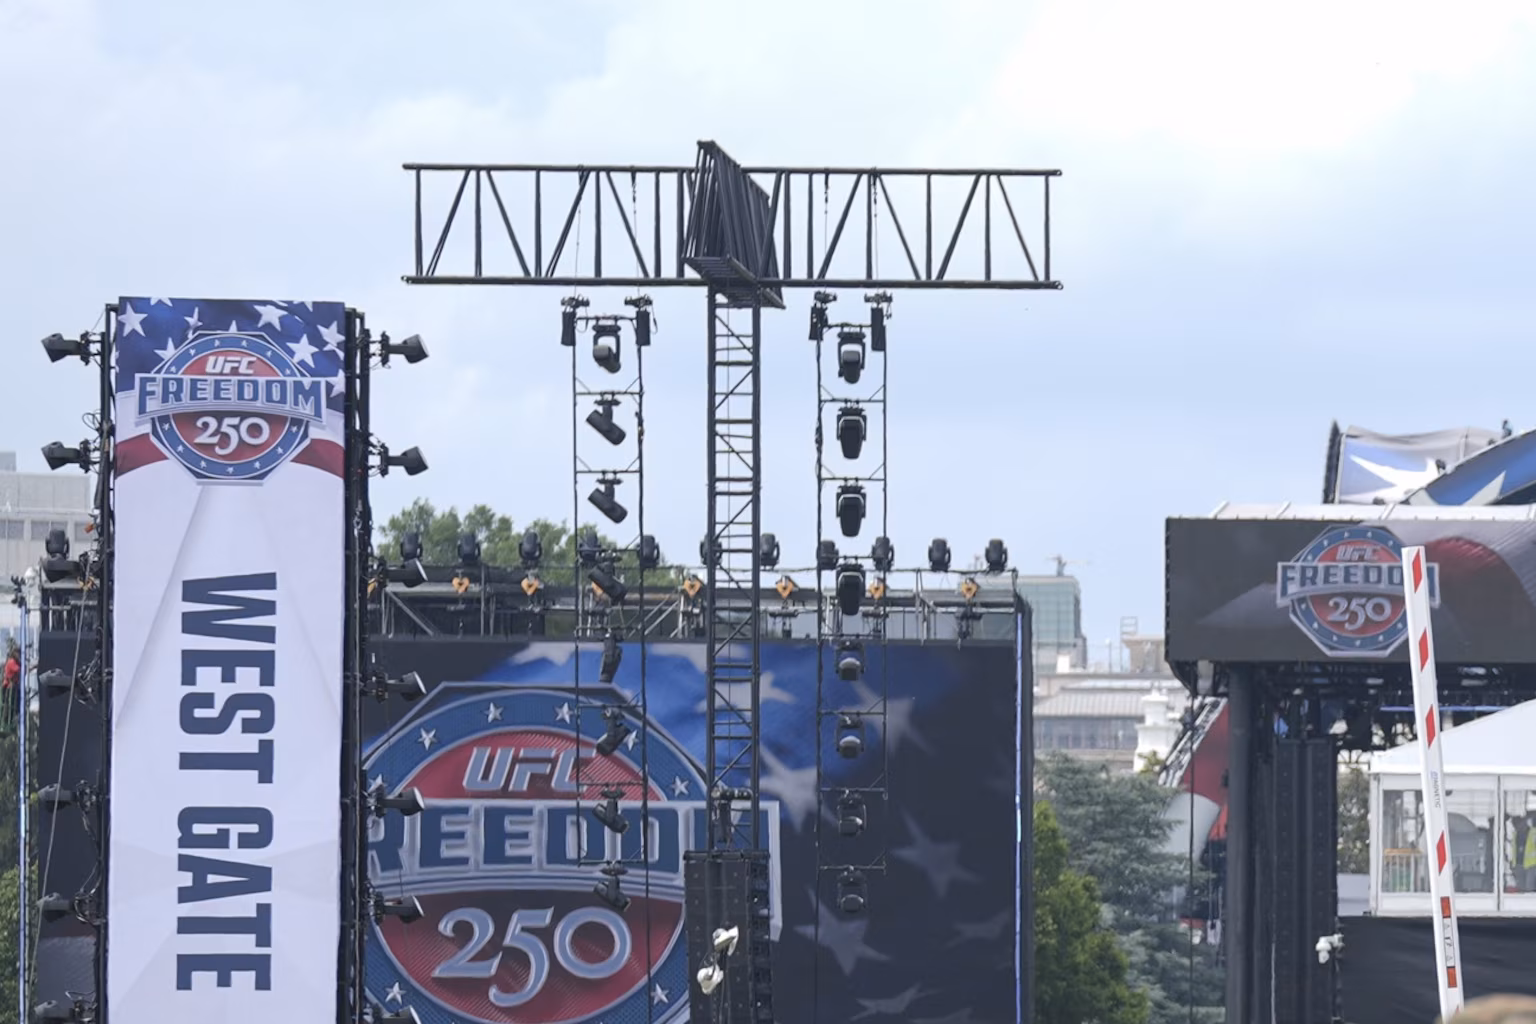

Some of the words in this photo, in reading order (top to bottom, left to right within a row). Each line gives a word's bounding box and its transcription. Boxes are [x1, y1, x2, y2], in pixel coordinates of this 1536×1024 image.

[205, 355, 257, 374] UFC
[138, 376, 324, 420] FREEDOM
[193, 416, 271, 455] 250
[1280, 564, 1435, 598] FREEDO
[1328, 596, 1392, 630] 250
[179, 571, 277, 784] WEST
[462, 746, 598, 793] UFC
[176, 806, 273, 991] GATE
[431, 906, 632, 1007] 250
